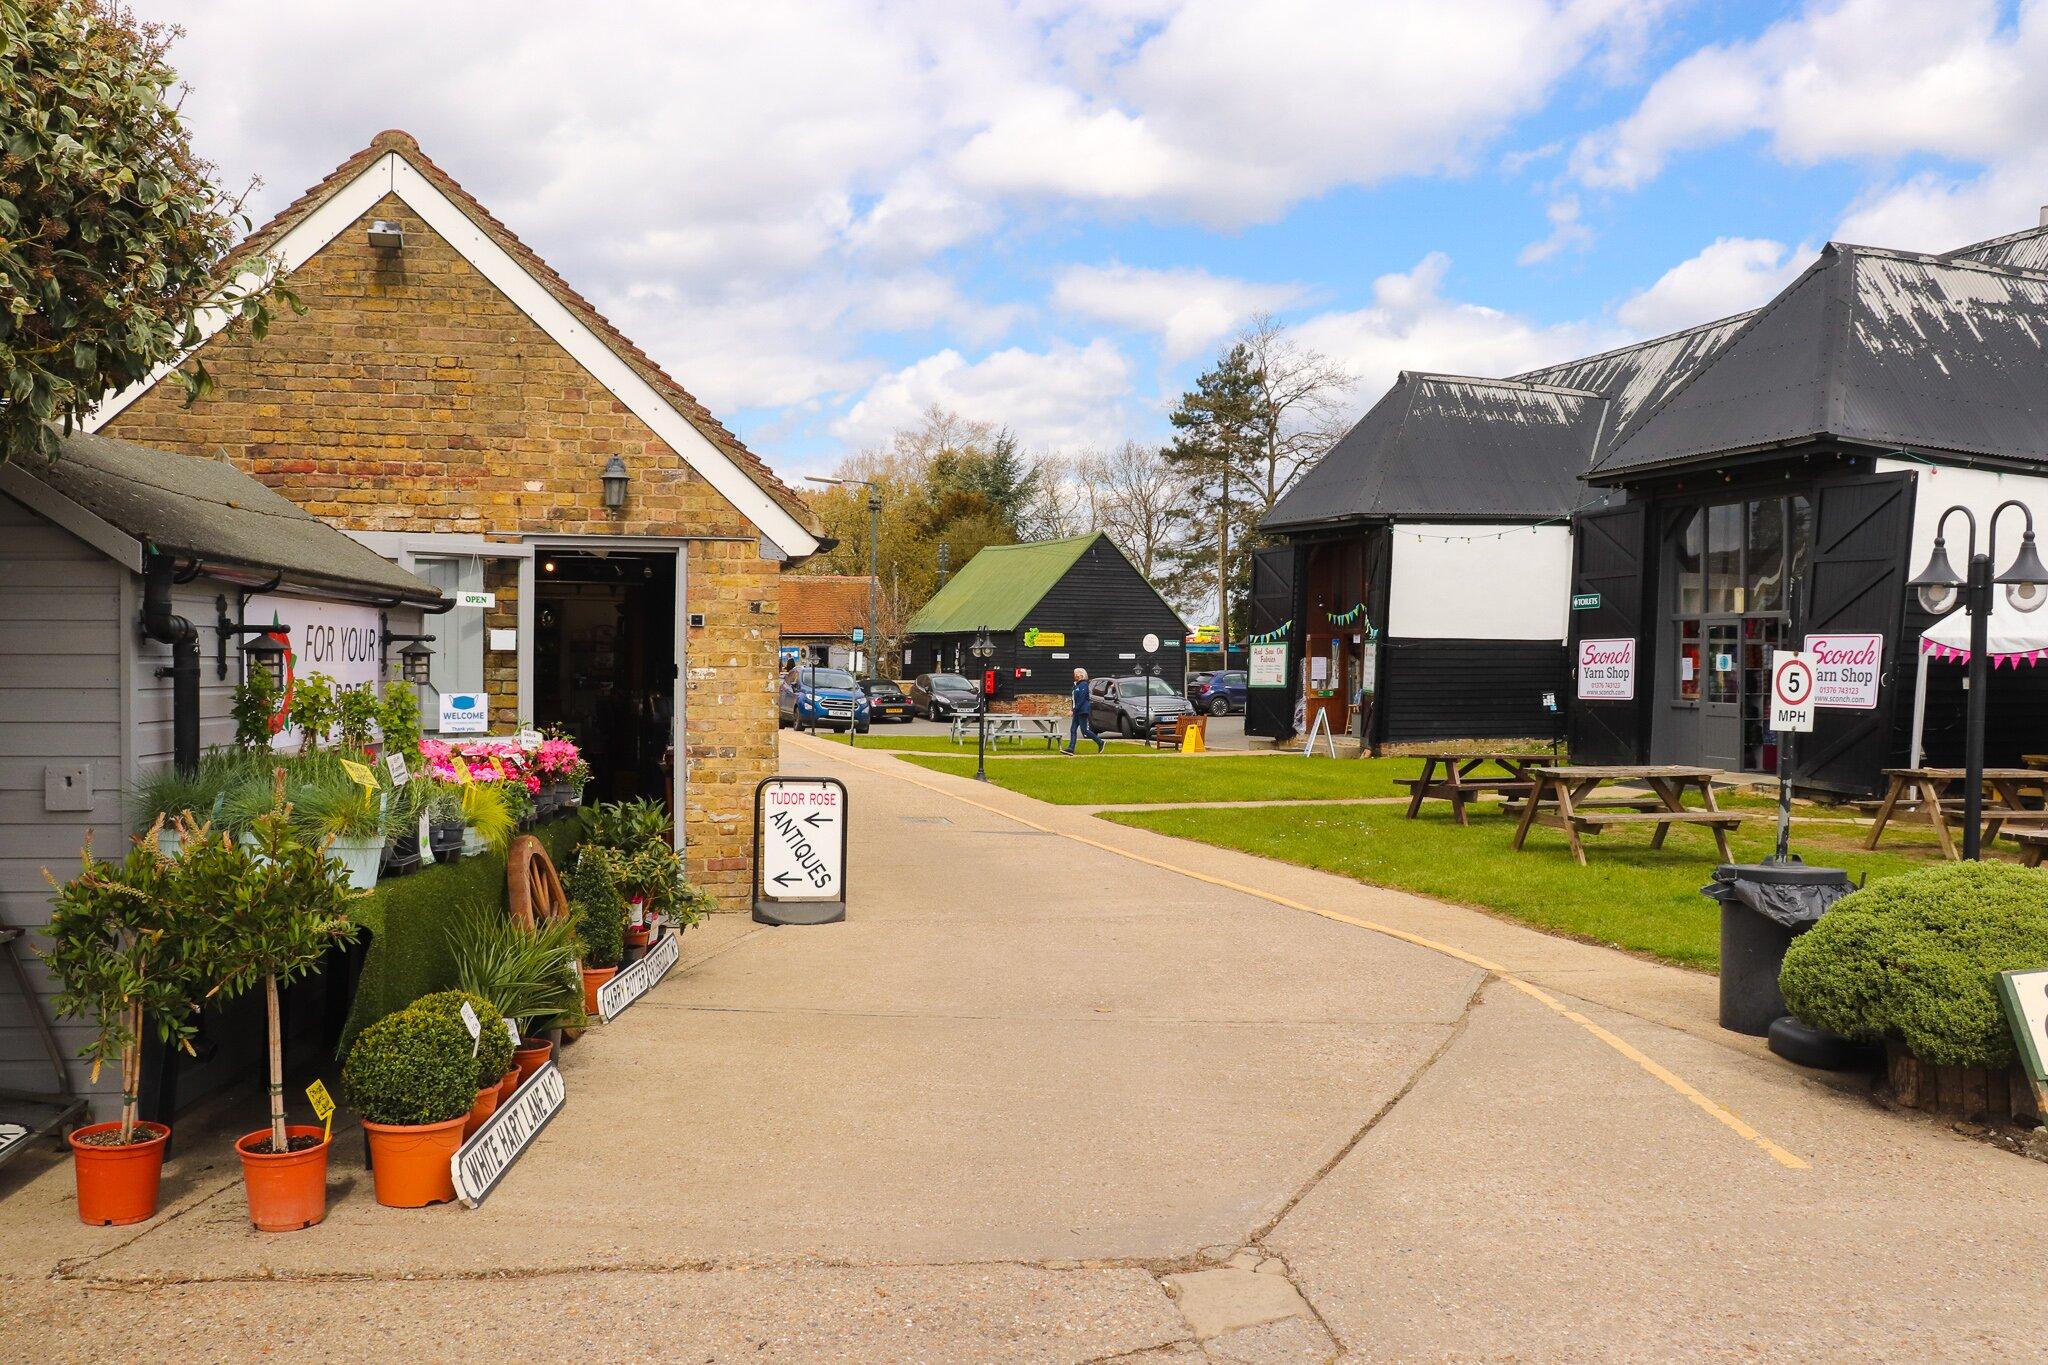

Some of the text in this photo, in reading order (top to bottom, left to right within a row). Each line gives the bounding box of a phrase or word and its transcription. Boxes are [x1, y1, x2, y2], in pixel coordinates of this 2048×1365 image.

[465, 595, 487, 604] OPEN
[1577, 598, 1598, 606] TOILETS
[305, 625, 376, 662] FOR YOUR
[1582, 643, 1631, 665] Sconch
[1813, 640, 1876, 665] Sconch
[1583, 666, 1630, 682] Yarn Shop
[1788, 672, 1800, 693] 5
[1816, 668, 1873, 686] arn Shop
[1819, 686, 1860, 695] 01376 743123
[443, 711, 485, 720] WELCOME
[1778, 710, 1806, 722] MPH
[770, 792, 836, 805] TUDOR ROSE
[770, 811, 832, 889] ANTIQUES
[465, 1135, 503, 1192] WHITE
[497, 1110, 526, 1159] HART
[520, 1086, 548, 1132] LANE
